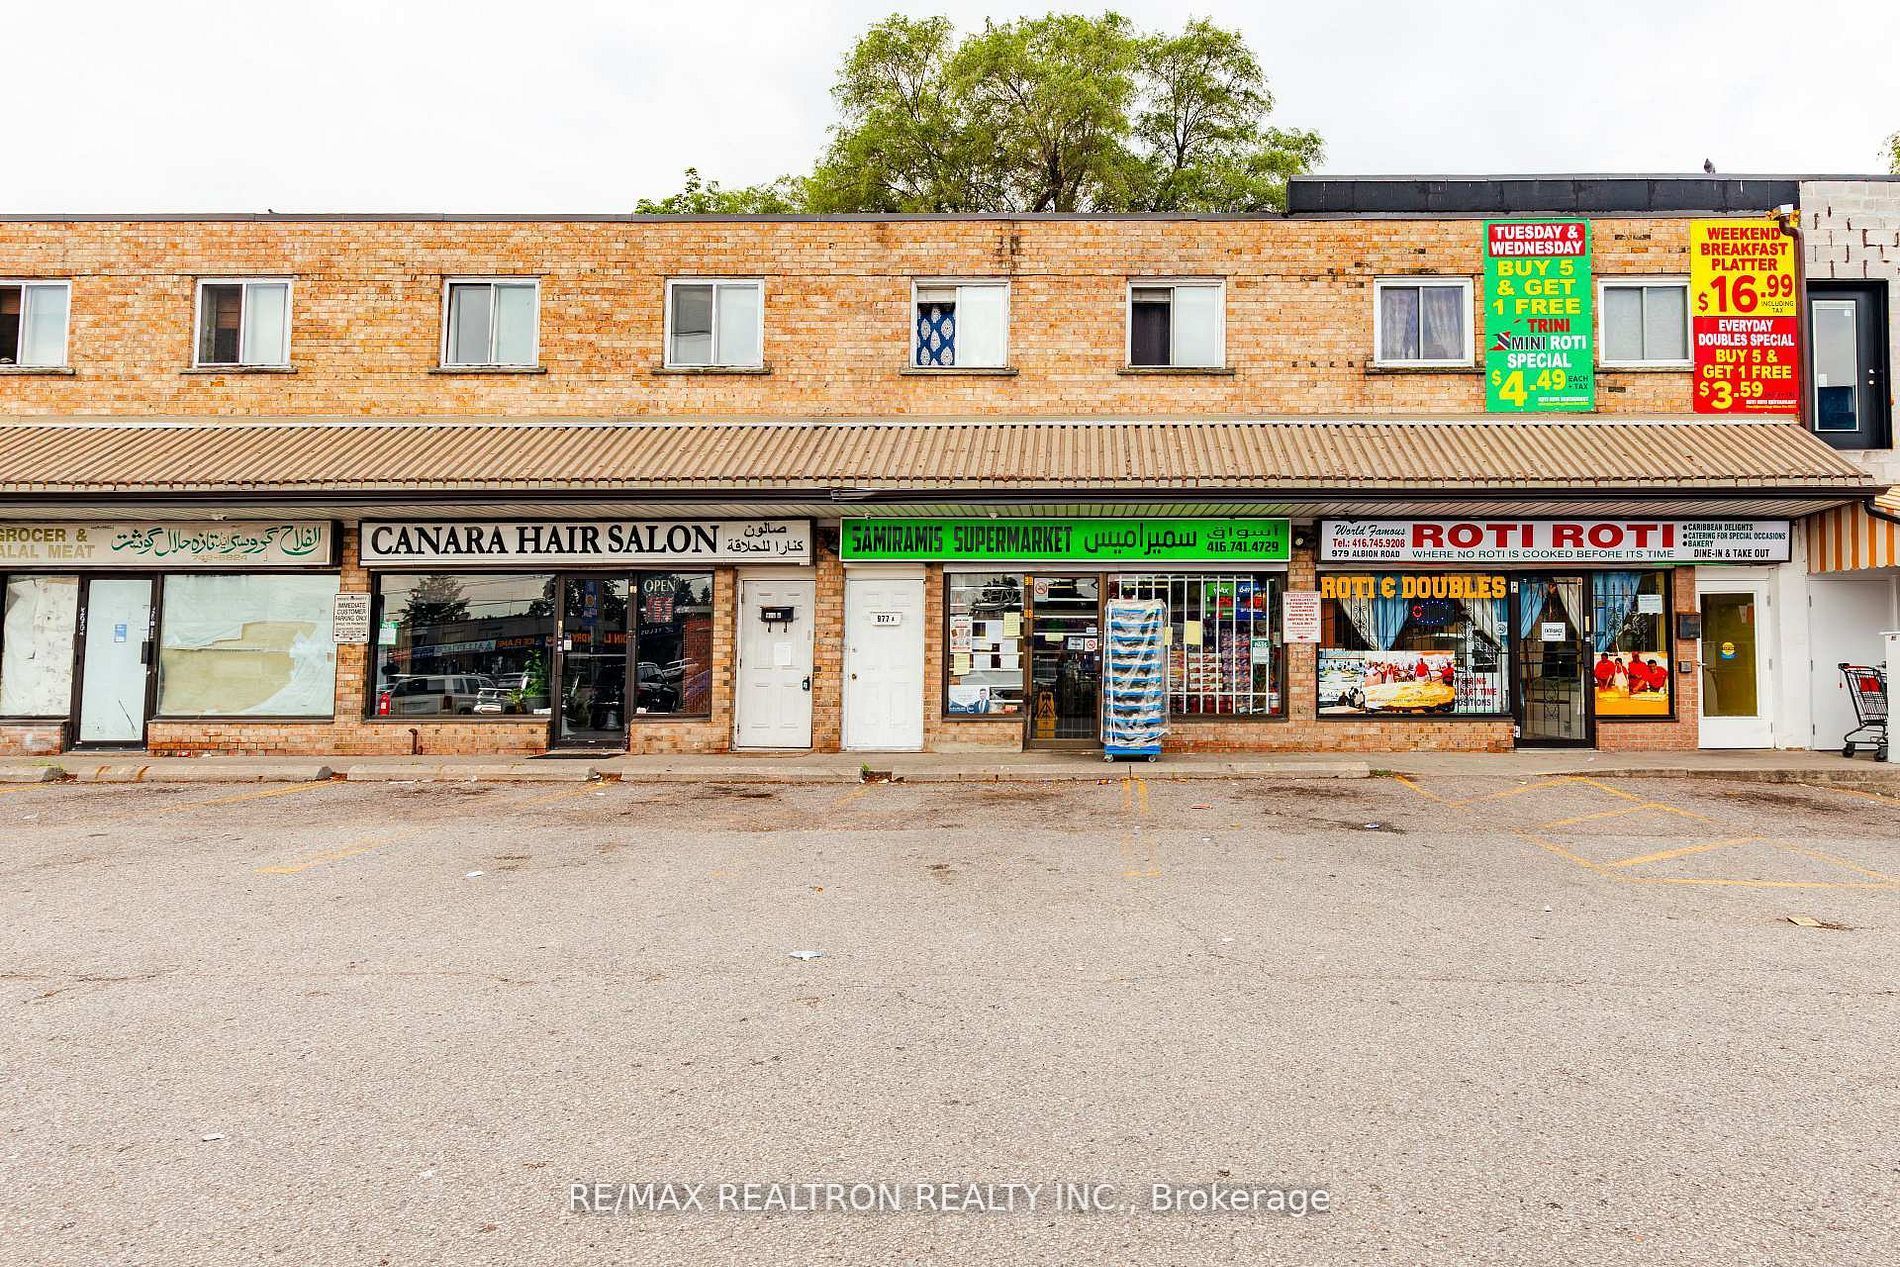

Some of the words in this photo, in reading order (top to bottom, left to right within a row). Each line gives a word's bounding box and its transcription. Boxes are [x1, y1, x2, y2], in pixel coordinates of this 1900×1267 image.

[1495, 226, 1563, 239] TUESDAY
[1567, 225, 1578, 239] &
[1707, 227, 1781, 240] WEEKEND
[1491, 241, 1583, 255] WEDNESDAY
[1700, 243, 1788, 256] BREAKFAST
[1497, 260, 1548, 276] BUY
[1559, 260, 1574, 276] 5
[1711, 258, 1777, 271] PLATTER
[1497, 279, 1515, 296] &
[1524, 279, 1576, 295] GET
[1492, 298, 1504, 315] 1
[1515, 298, 1581, 315] FREE
[1528, 319, 1570, 333] TRINI
[1719, 320, 1773, 332] EVERYDAY
[1511, 336, 1546, 350] MINI
[1550, 335, 1586, 349] ROTI
[1698, 334, 1747, 346] DOUBLES
[1750, 334, 1795, 346] SPECIAL
[1507, 352, 1572, 368] SPECIAL
[1716, 349, 1748, 363] BUY
[1752, 349, 1761, 363] 5
[1766, 350, 1778, 363] &
[1703, 365, 1734, 379] GET
[1739, 366, 1746, 379] 1
[1751, 365, 1792, 379] FREE
[744, 522, 786, 537] صالون
[1335, 524, 1366, 536] World
[1368, 525, 1405, 537] Famous
[1688, 523, 1723, 531] CARIBBEAN
[1724, 523, 1753, 531] DELIGHTS
[76, 528, 87, 542] &
[371, 526, 508, 554] CANARA
[516, 526, 602, 554] HAIR
[608, 525, 719, 553] SALON
[852, 526, 943, 552] SAMIRAMIS
[953, 526, 1073, 552] SUPERMARKET
[1084, 522, 1197, 555] سميراميس
[1412, 523, 1534, 548] ROTI
[1552, 523, 1674, 548] ROTI
[1688, 532, 1716, 540] CATERING
[726, 539, 770, 552] للحلاقة
[776, 540, 803, 555] كنارا
[1206, 541, 1279, 552] 416.741.4729
[1332, 538, 1350, 548] Tel.:
[1352, 538, 1405, 548] 416.745.9208
[49, 545, 95, 558] MEAT
[1331, 550, 1349, 558] 979
[1352, 550, 1379, 558] ALBION
[1412, 550, 1454, 558] WHERE
[1458, 550, 1475, 558] NO
[1479, 550, 1505, 558] ROTI
[1509, 550, 1518, 558] IS
[1522, 550, 1573, 558] COOKED
[1577, 550, 1622, 558] BEFORE
[1626, 550, 1643, 558] ITS
[1647, 550, 1674, 558] TIME
[1694, 549, 1723, 557] DINE-IN
[1725, 549, 1730, 557] &
[1733, 549, 1752, 557] TAKE
[1754, 549, 1770, 557] OUT
[644, 580, 676, 592] OPEN
[1321, 576, 1375, 598] ROTI
[1402, 576, 1506, 598] DOUBLES
